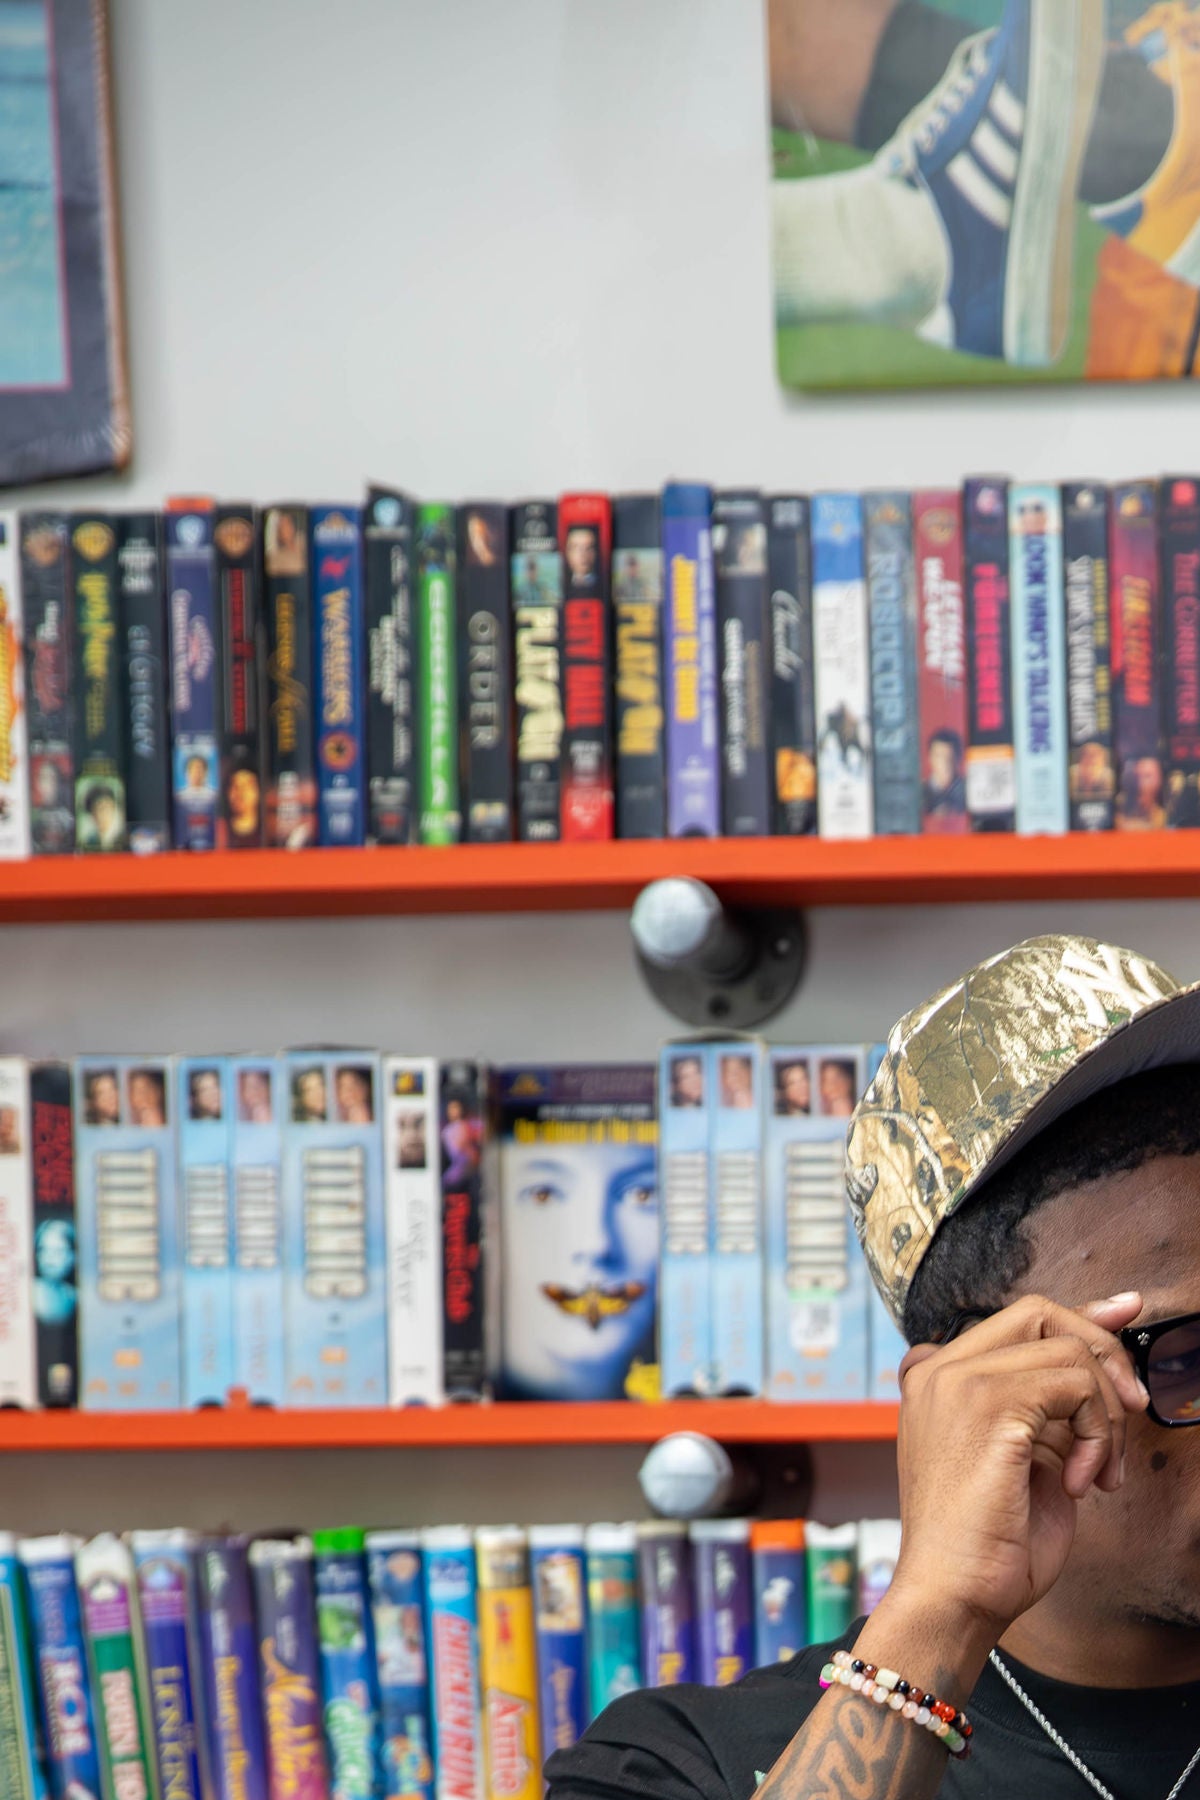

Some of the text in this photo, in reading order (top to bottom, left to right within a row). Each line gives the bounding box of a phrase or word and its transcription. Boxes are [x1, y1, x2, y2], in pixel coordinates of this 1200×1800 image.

[467, 611, 500, 749] ORDER
[515, 606, 564, 760] PLATOON
[1031, 667, 1052, 754] TALKING
[153, 1665, 183, 1735] LION
[263, 1638, 316, 1795] Aladdin
[435, 1612, 473, 1728] CHICKEN
[491, 1694, 528, 1794] Annie
